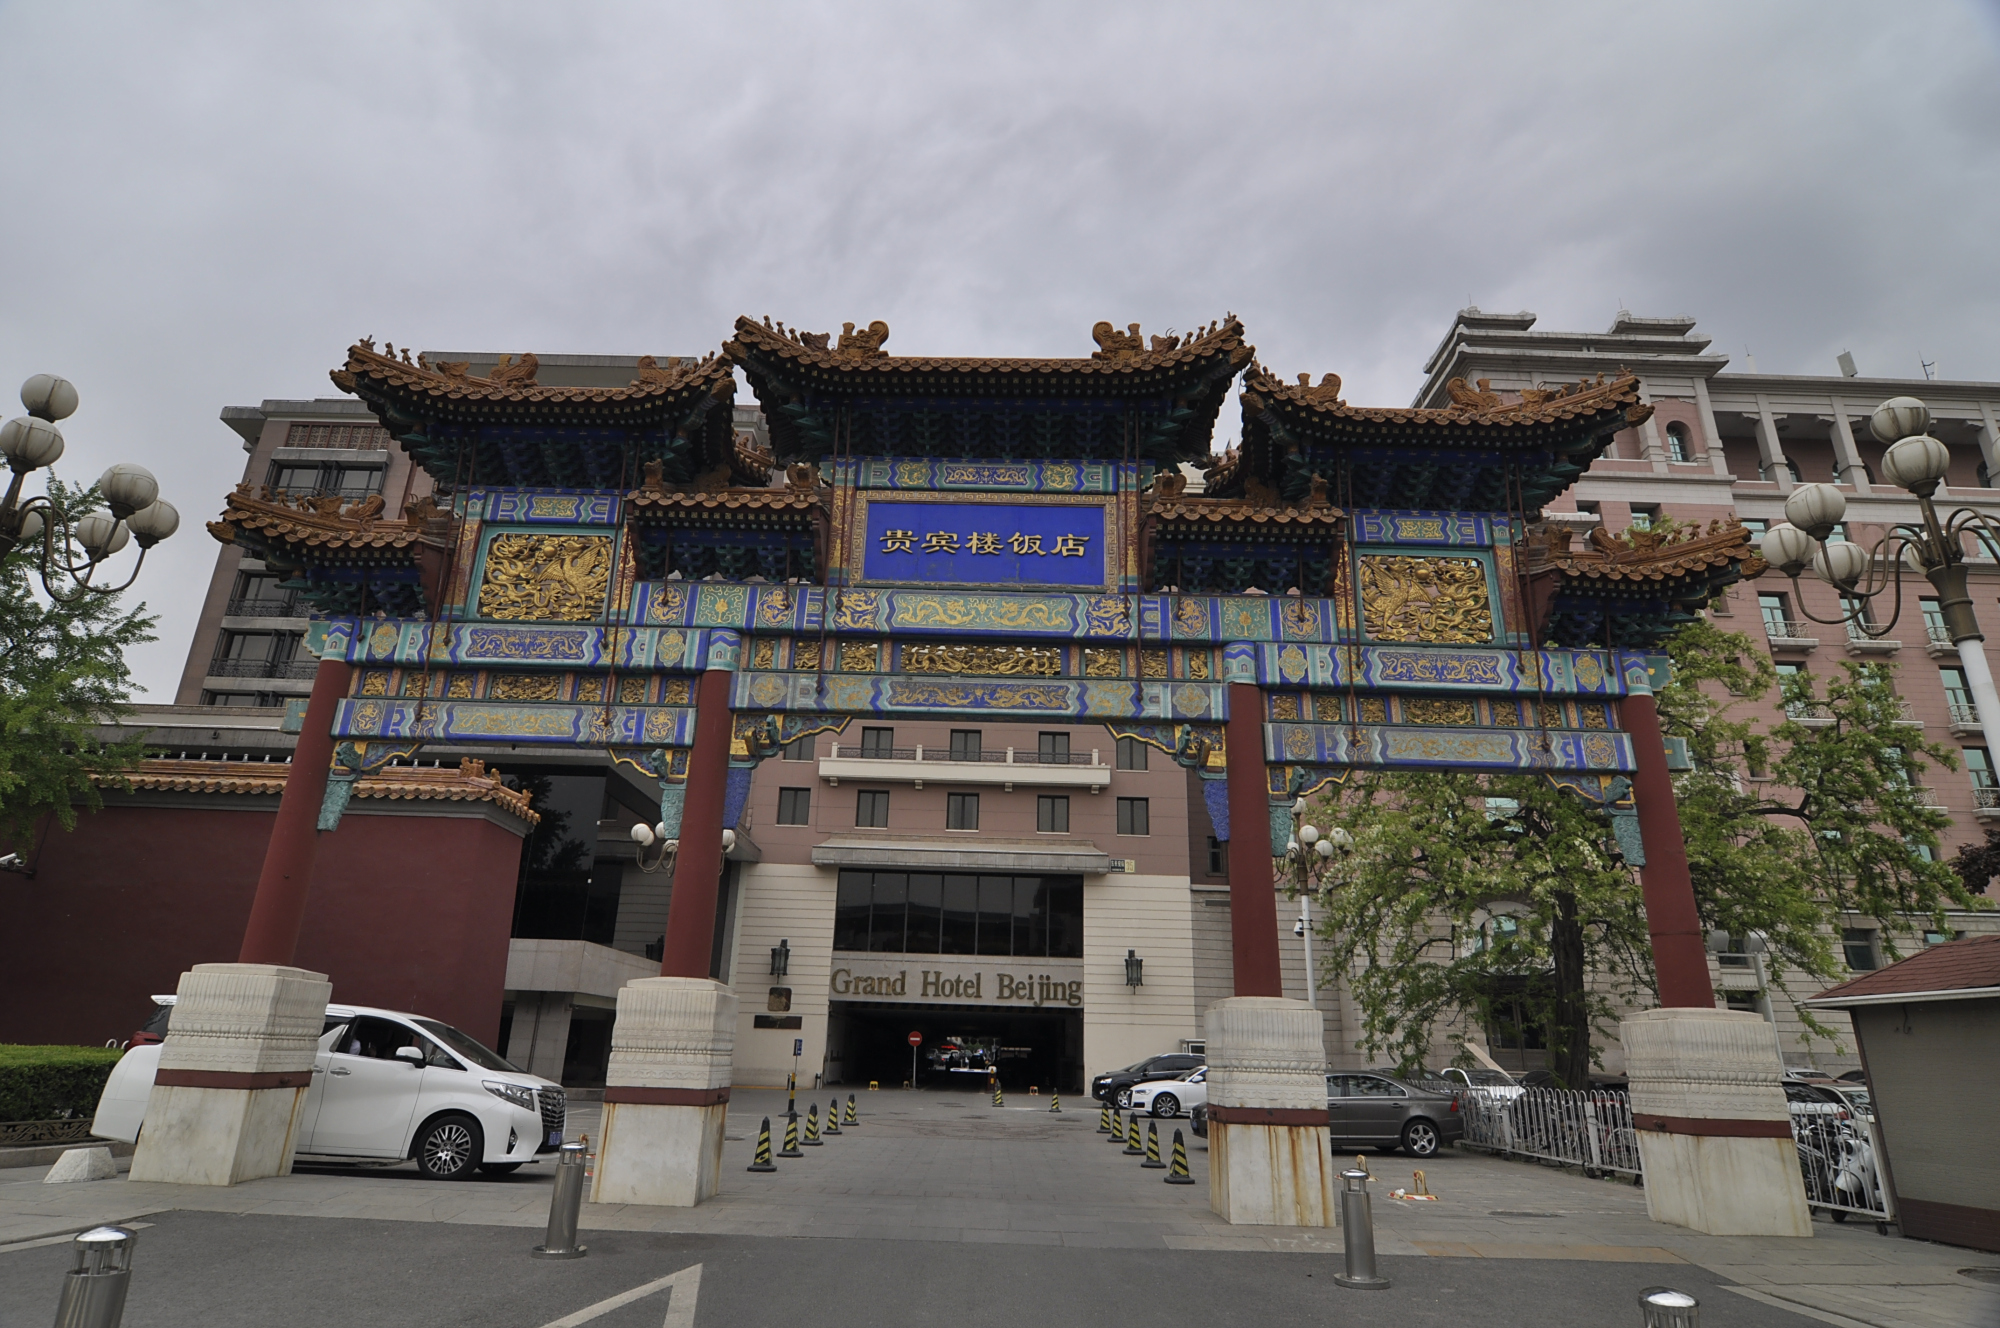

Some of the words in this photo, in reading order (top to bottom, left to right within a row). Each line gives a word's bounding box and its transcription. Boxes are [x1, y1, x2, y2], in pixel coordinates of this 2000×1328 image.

[880, 529, 1090, 557] 贵宾楼饭店
[831, 968, 906, 996] Grand
[921, 970, 983, 998] Hotel
[996, 973, 1083, 1006] Beijing
